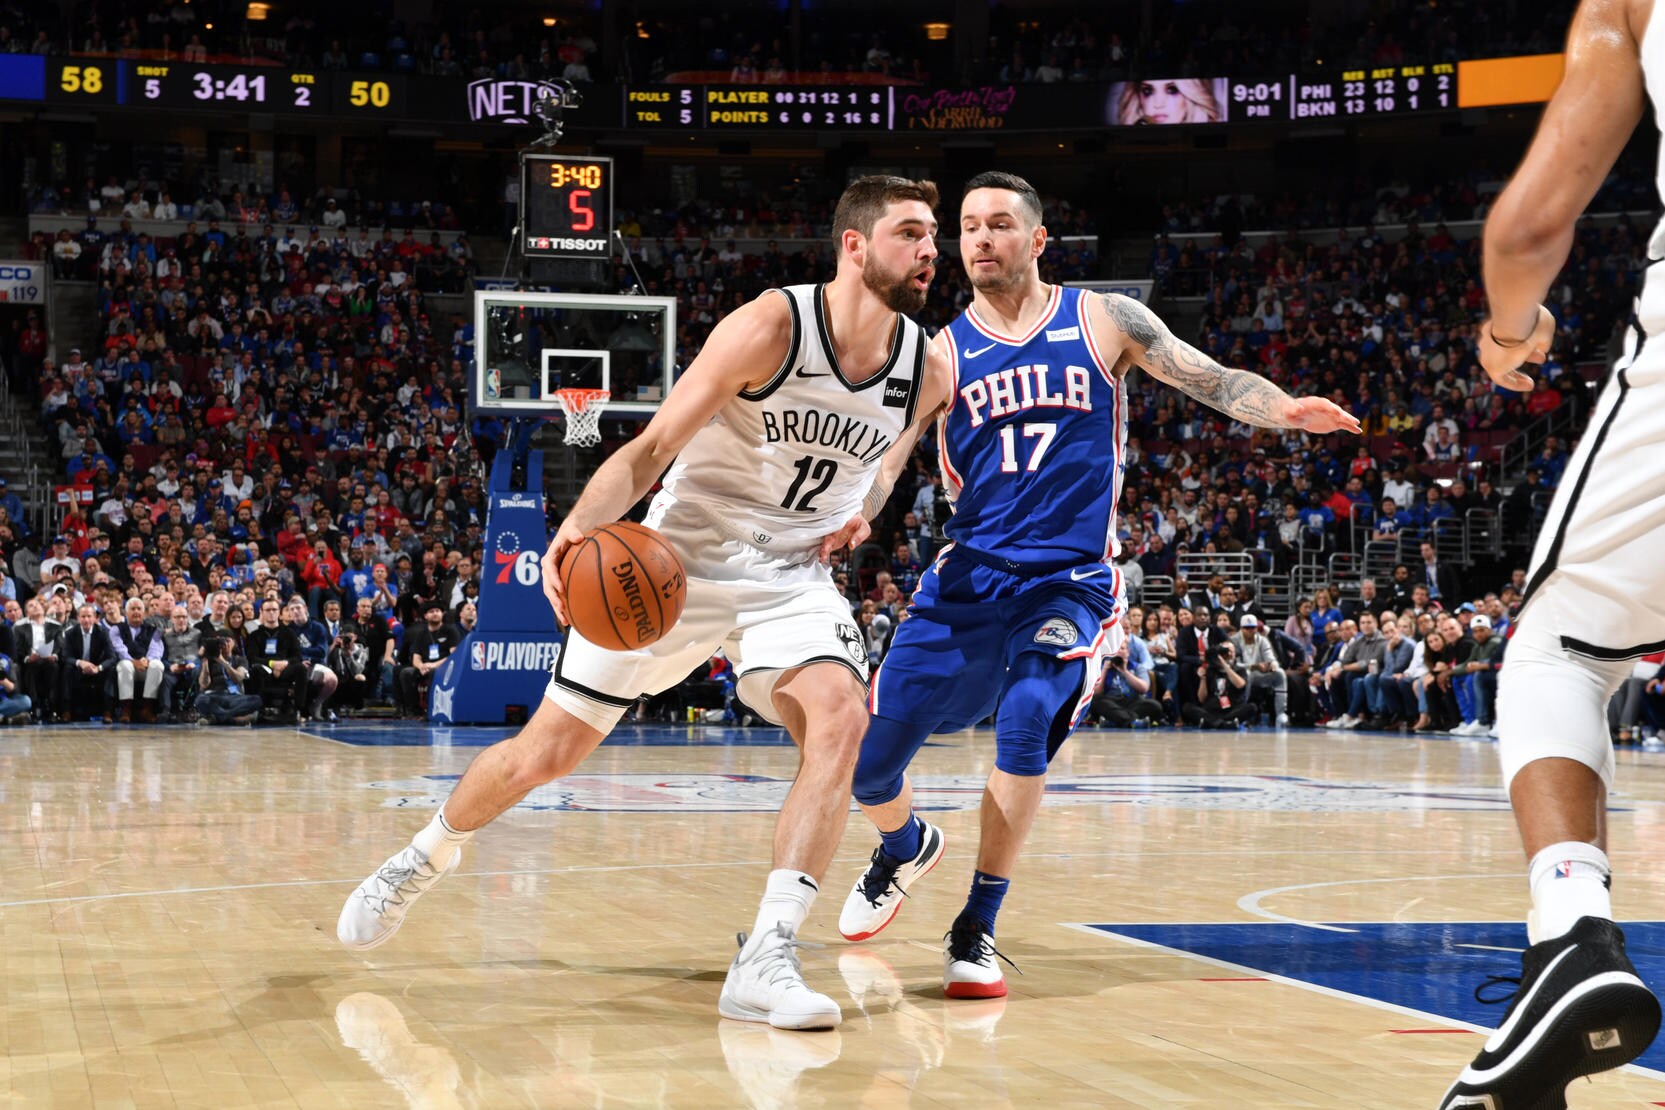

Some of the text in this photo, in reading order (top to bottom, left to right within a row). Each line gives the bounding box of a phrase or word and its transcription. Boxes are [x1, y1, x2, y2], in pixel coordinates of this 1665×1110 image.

[61, 66, 102, 93] 58
[137, 66, 169, 77] SHOT
[1371, 68, 1396, 79] AST
[1433, 64, 1454, 74] STL
[145, 80, 160, 99] 5
[193, 73, 266, 101] 3:41
[294, 87, 311, 106] 2
[350, 81, 390, 107] 50
[1233, 83, 1281, 101] 9:01
[1301, 76, 1449, 100] PHI 23 12 0 2
[629, 90, 692, 104] FOULS 5
[707, 92, 769, 103] PLAYER
[775, 92, 794, 104] 00
[798, 92, 816, 104] 31
[820, 92, 839, 104] 12
[847, 92, 857, 104] 1
[1297, 93, 1448, 117] BKN 13 10 1 1
[636, 109, 692, 124] TOL 5
[710, 111, 769, 123] POINTS
[779, 112, 789, 123] 6
[802, 112, 812, 123] 0
[825, 112, 835, 123] 2
[844, 112, 862, 124] 16
[1247, 105, 1270, 117] PM
[551, 164, 601, 189] 3:40
[569, 190, 594, 231] 5
[550, 238, 607, 251] TISSOT
[13, 286, 38, 300] 119
[885, 387, 907, 398] infor
[960, 364, 1092, 428] PHILA
[1000, 423, 1057, 473] 17
[780, 455, 838, 512] 12
[495, 549, 540, 586] 76
